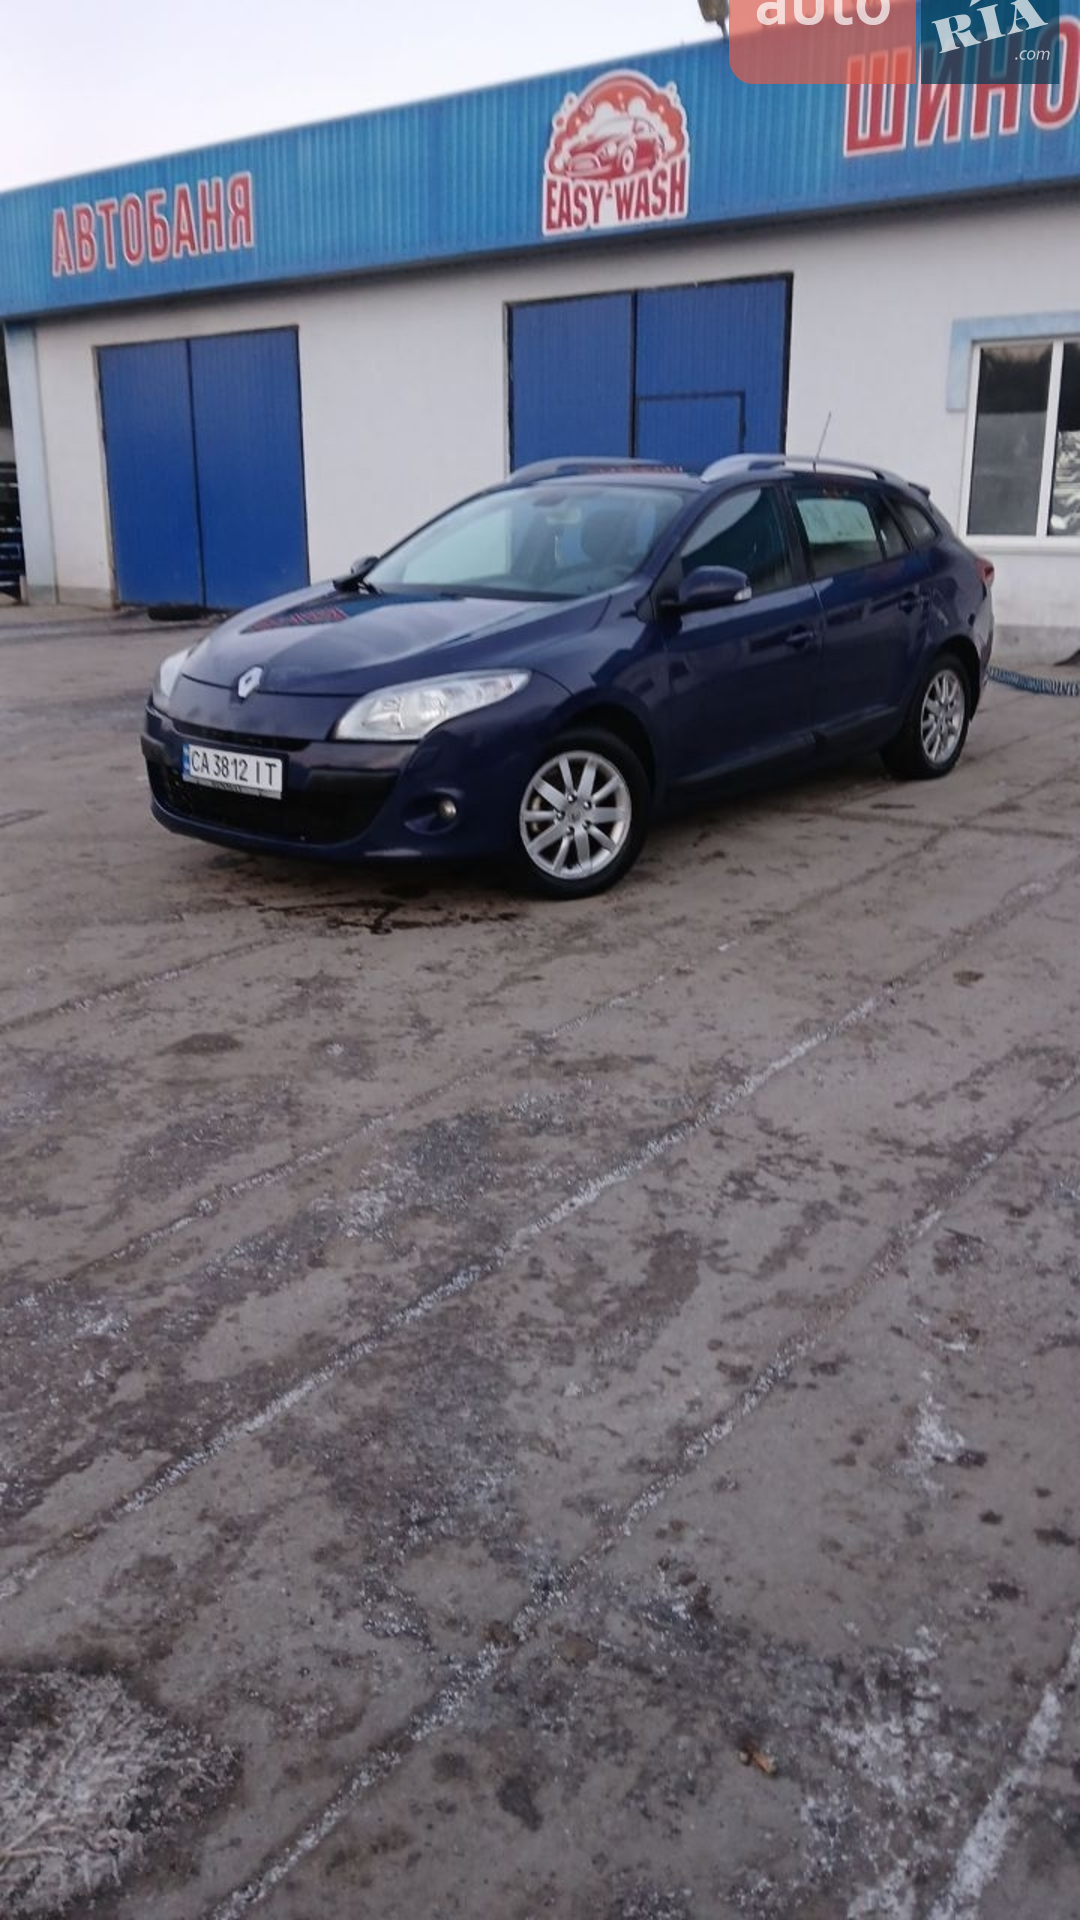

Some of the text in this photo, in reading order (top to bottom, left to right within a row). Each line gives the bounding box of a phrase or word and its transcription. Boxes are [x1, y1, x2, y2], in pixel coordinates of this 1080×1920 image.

[52, 171, 254, 277] АВТОБАНЯ
[191, 750, 210, 775] CA
[213, 753, 249, 782] 3812
